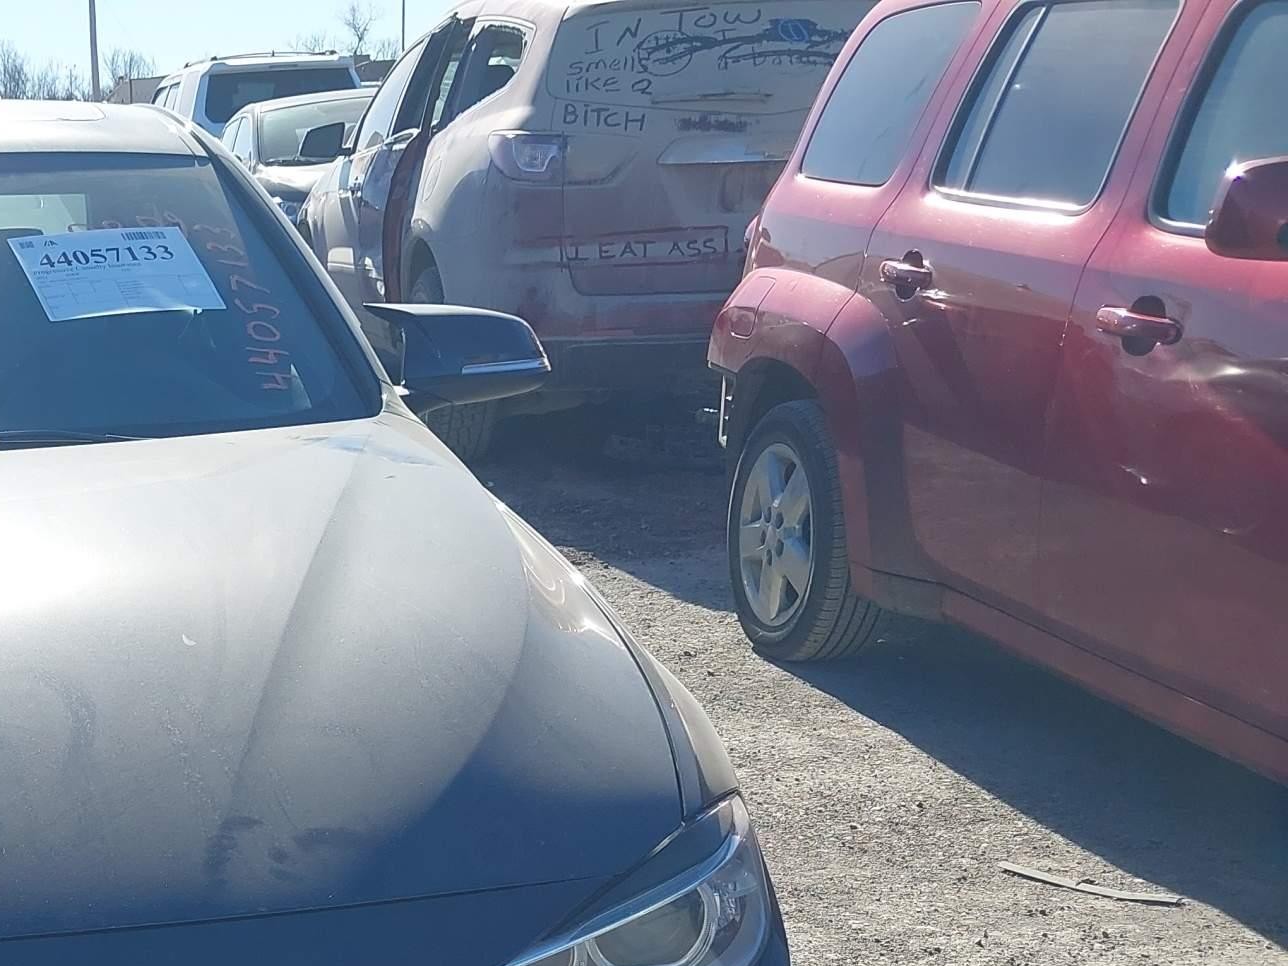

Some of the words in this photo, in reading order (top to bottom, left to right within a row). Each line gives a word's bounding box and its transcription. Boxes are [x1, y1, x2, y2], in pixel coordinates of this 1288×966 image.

[584, 17, 642, 54] IN
[660, 7, 762, 34] TOW
[39, 244, 175, 269] 44057133
[598, 240, 657, 260] EAT
[667, 238, 718, 257] ASS
